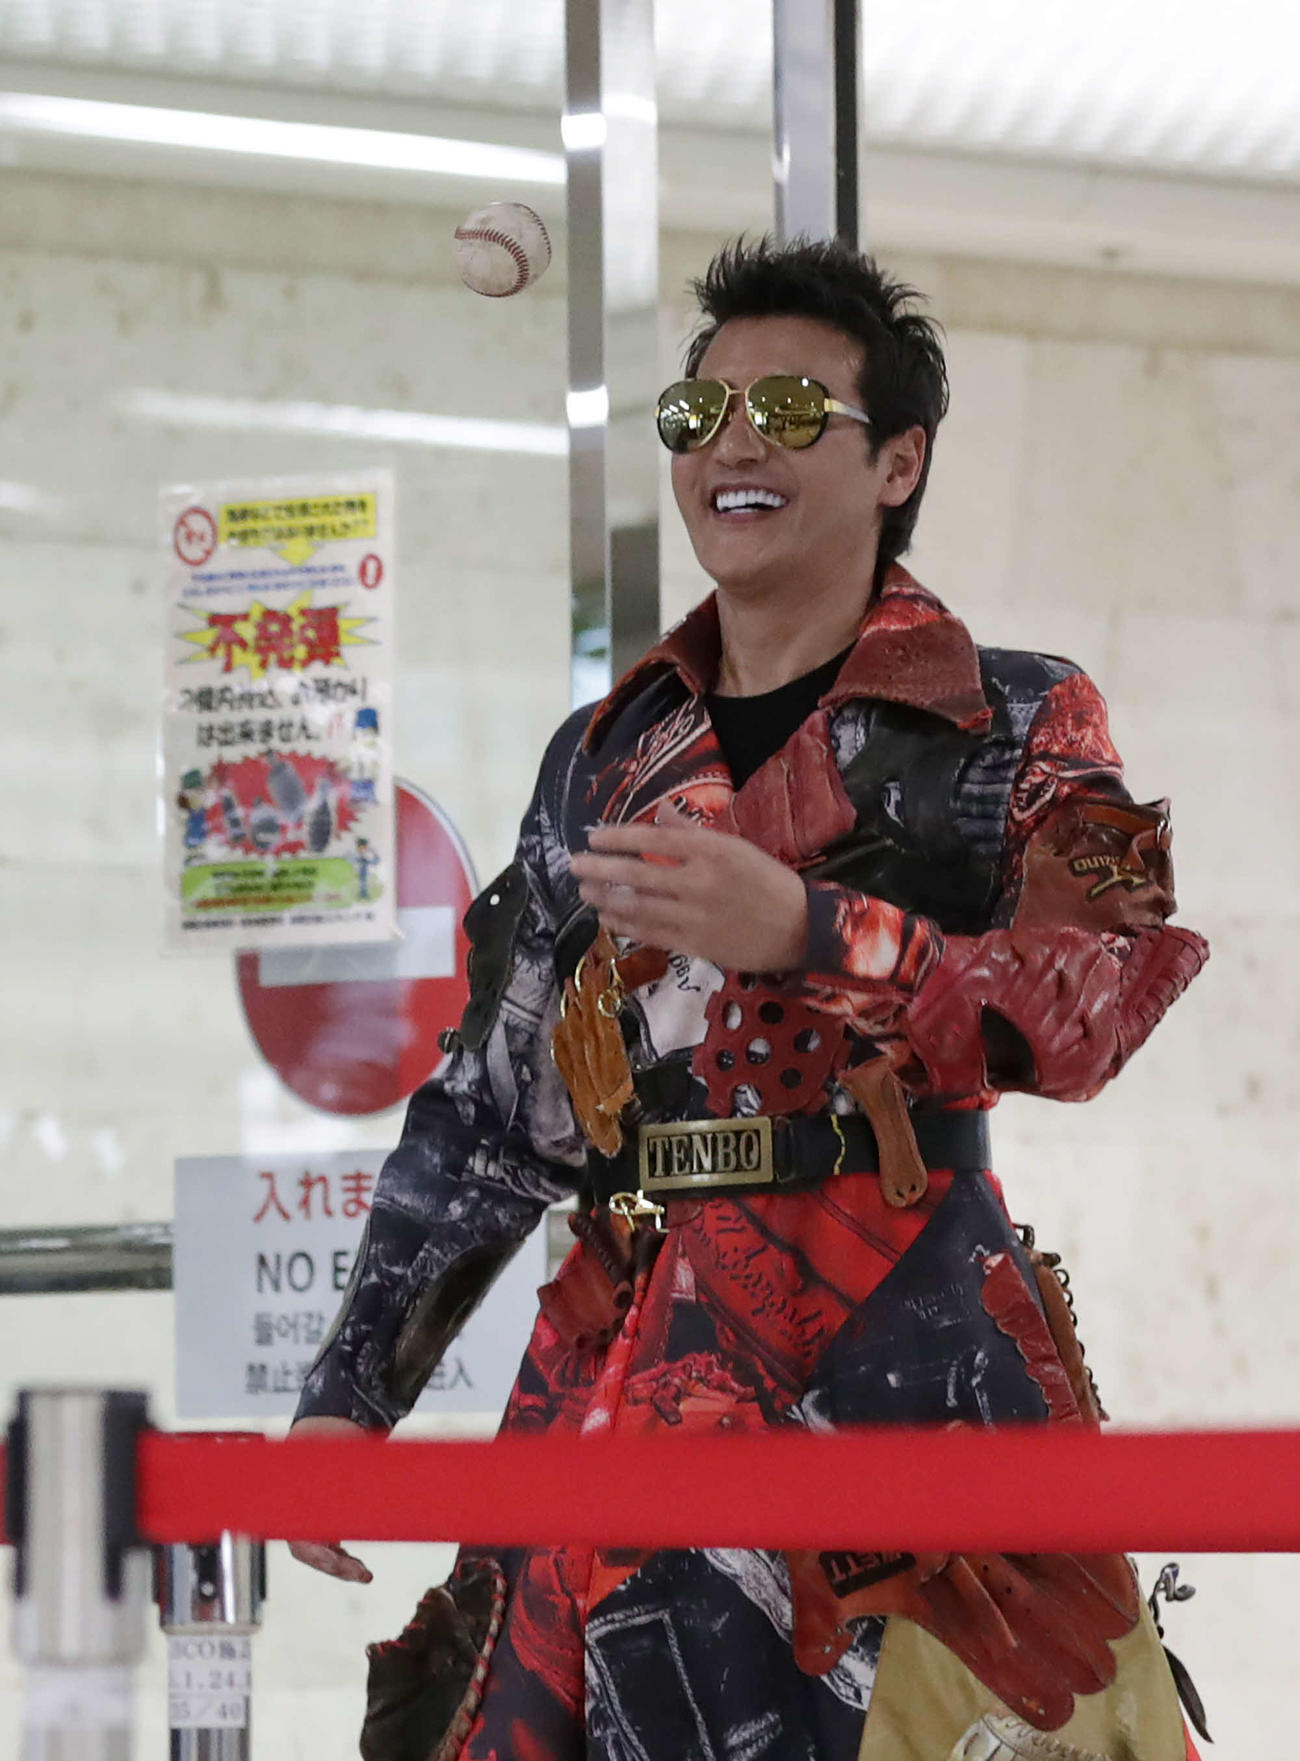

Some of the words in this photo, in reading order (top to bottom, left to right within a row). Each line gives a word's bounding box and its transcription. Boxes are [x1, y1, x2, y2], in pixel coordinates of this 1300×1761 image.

[650, 1130, 760, 1177] TENBO
[253, 1170, 374, 1223] 入れま
[257, 1251, 315, 1293] NO
